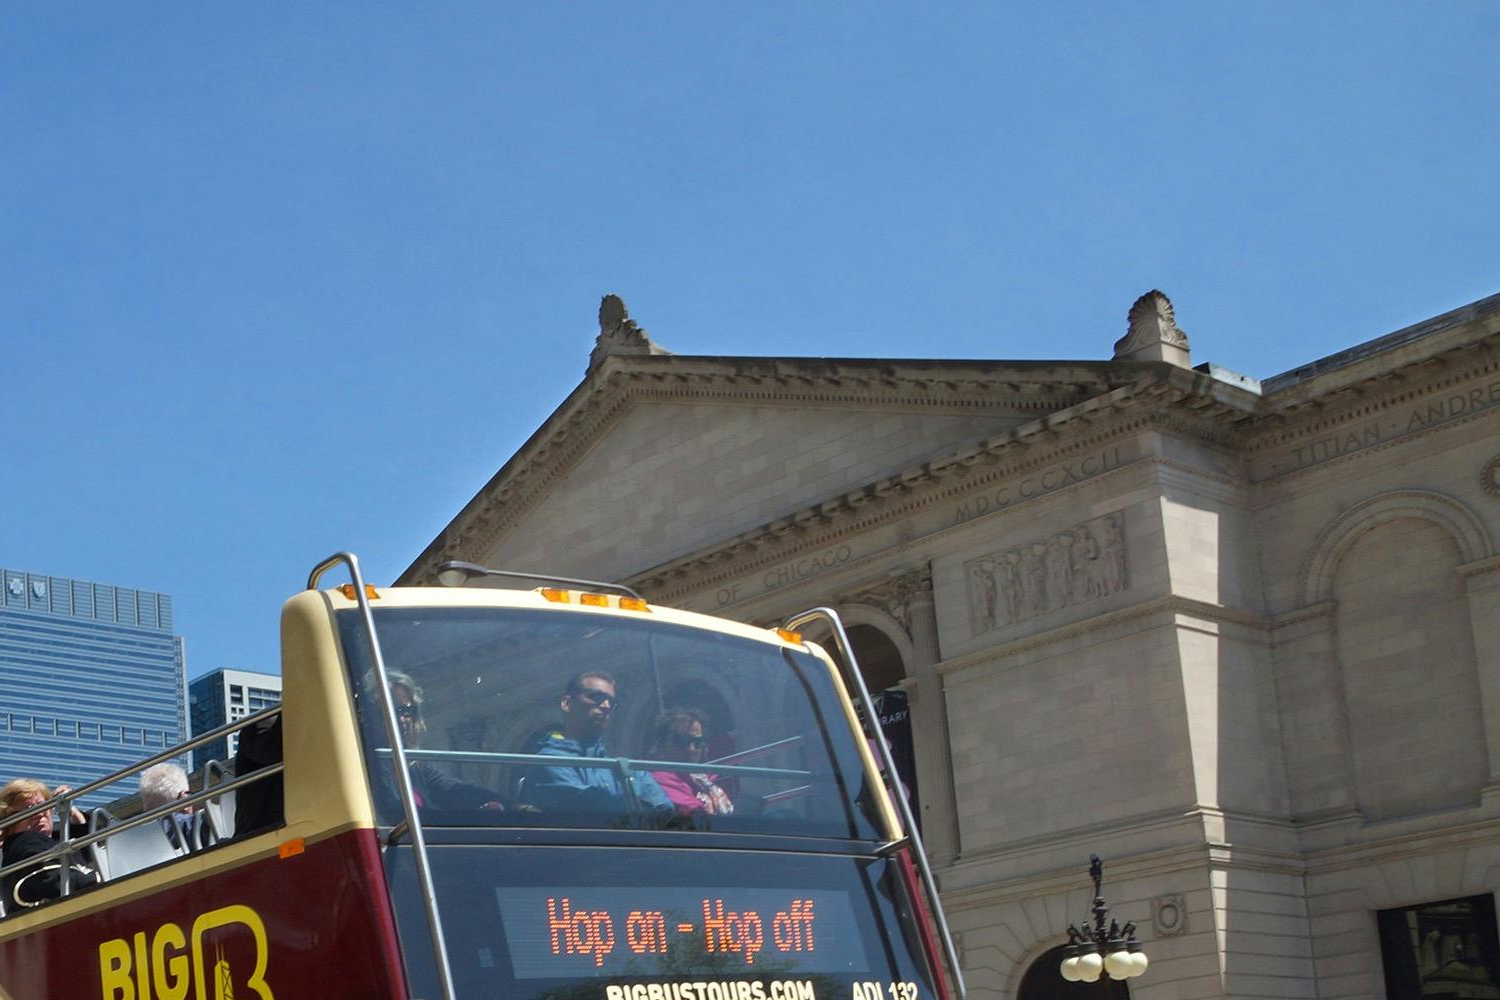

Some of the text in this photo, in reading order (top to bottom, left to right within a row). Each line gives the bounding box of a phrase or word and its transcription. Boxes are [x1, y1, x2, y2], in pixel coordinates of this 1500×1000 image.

[1291, 422, 1380, 463] TITIAN
[955, 447, 1121, 523] MDCCCXCII
[717, 546, 852, 606] OF CHICAGO
[547, 897, 615, 967] Hop
[626, 910, 668, 954] on
[702, 898, 765, 966] Hop
[773, 898, 815, 952] off
